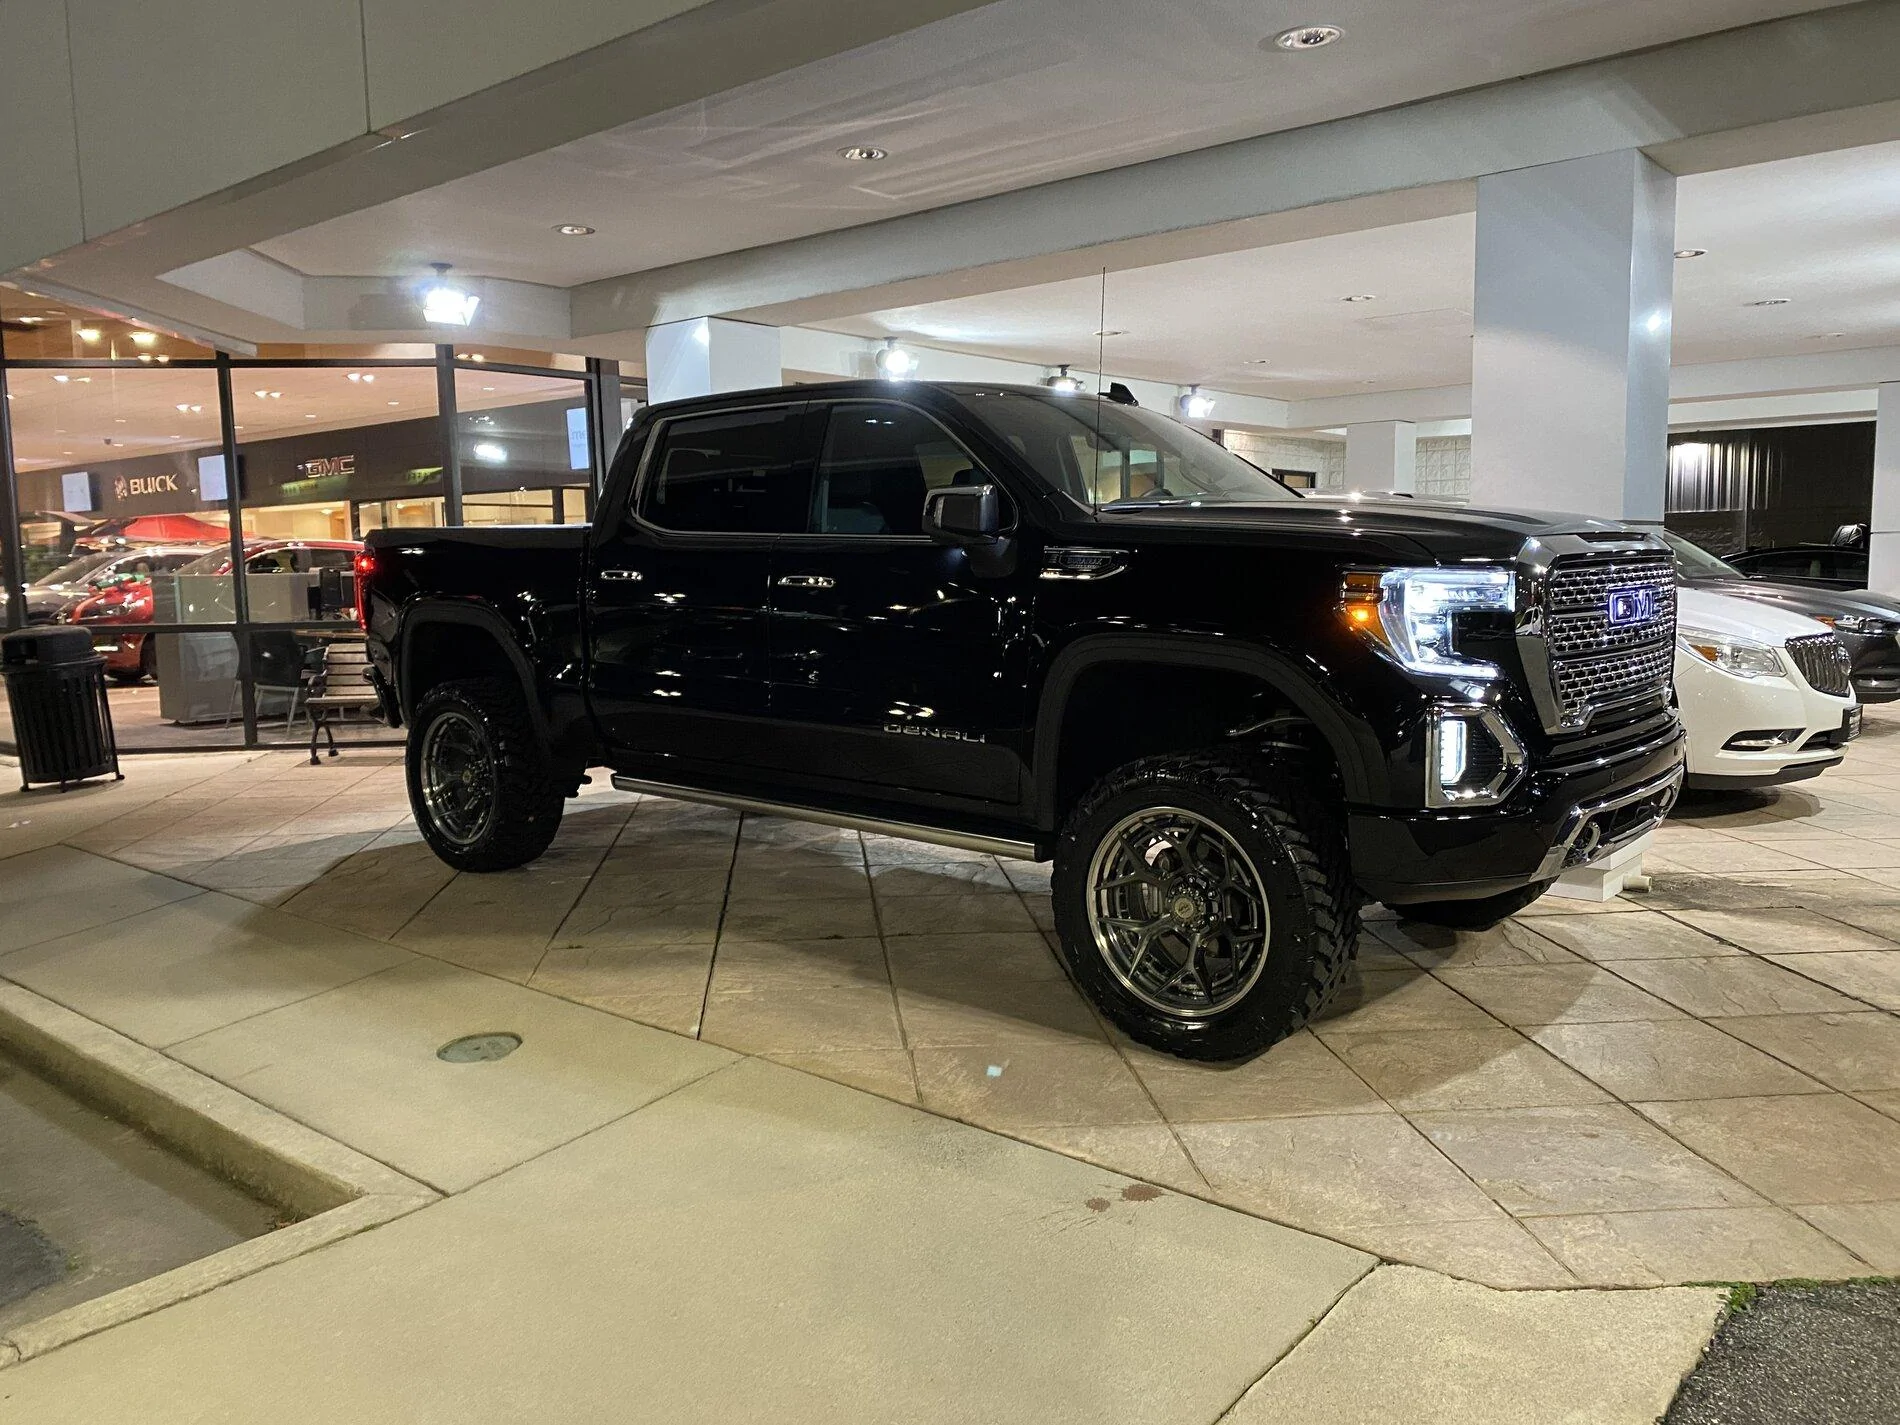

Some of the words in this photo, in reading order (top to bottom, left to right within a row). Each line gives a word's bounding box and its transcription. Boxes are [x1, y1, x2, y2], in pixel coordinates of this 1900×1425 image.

[305, 455, 354, 478] GMC
[130, 473, 178, 494] BUICK
[883, 723, 985, 743] DENALI
